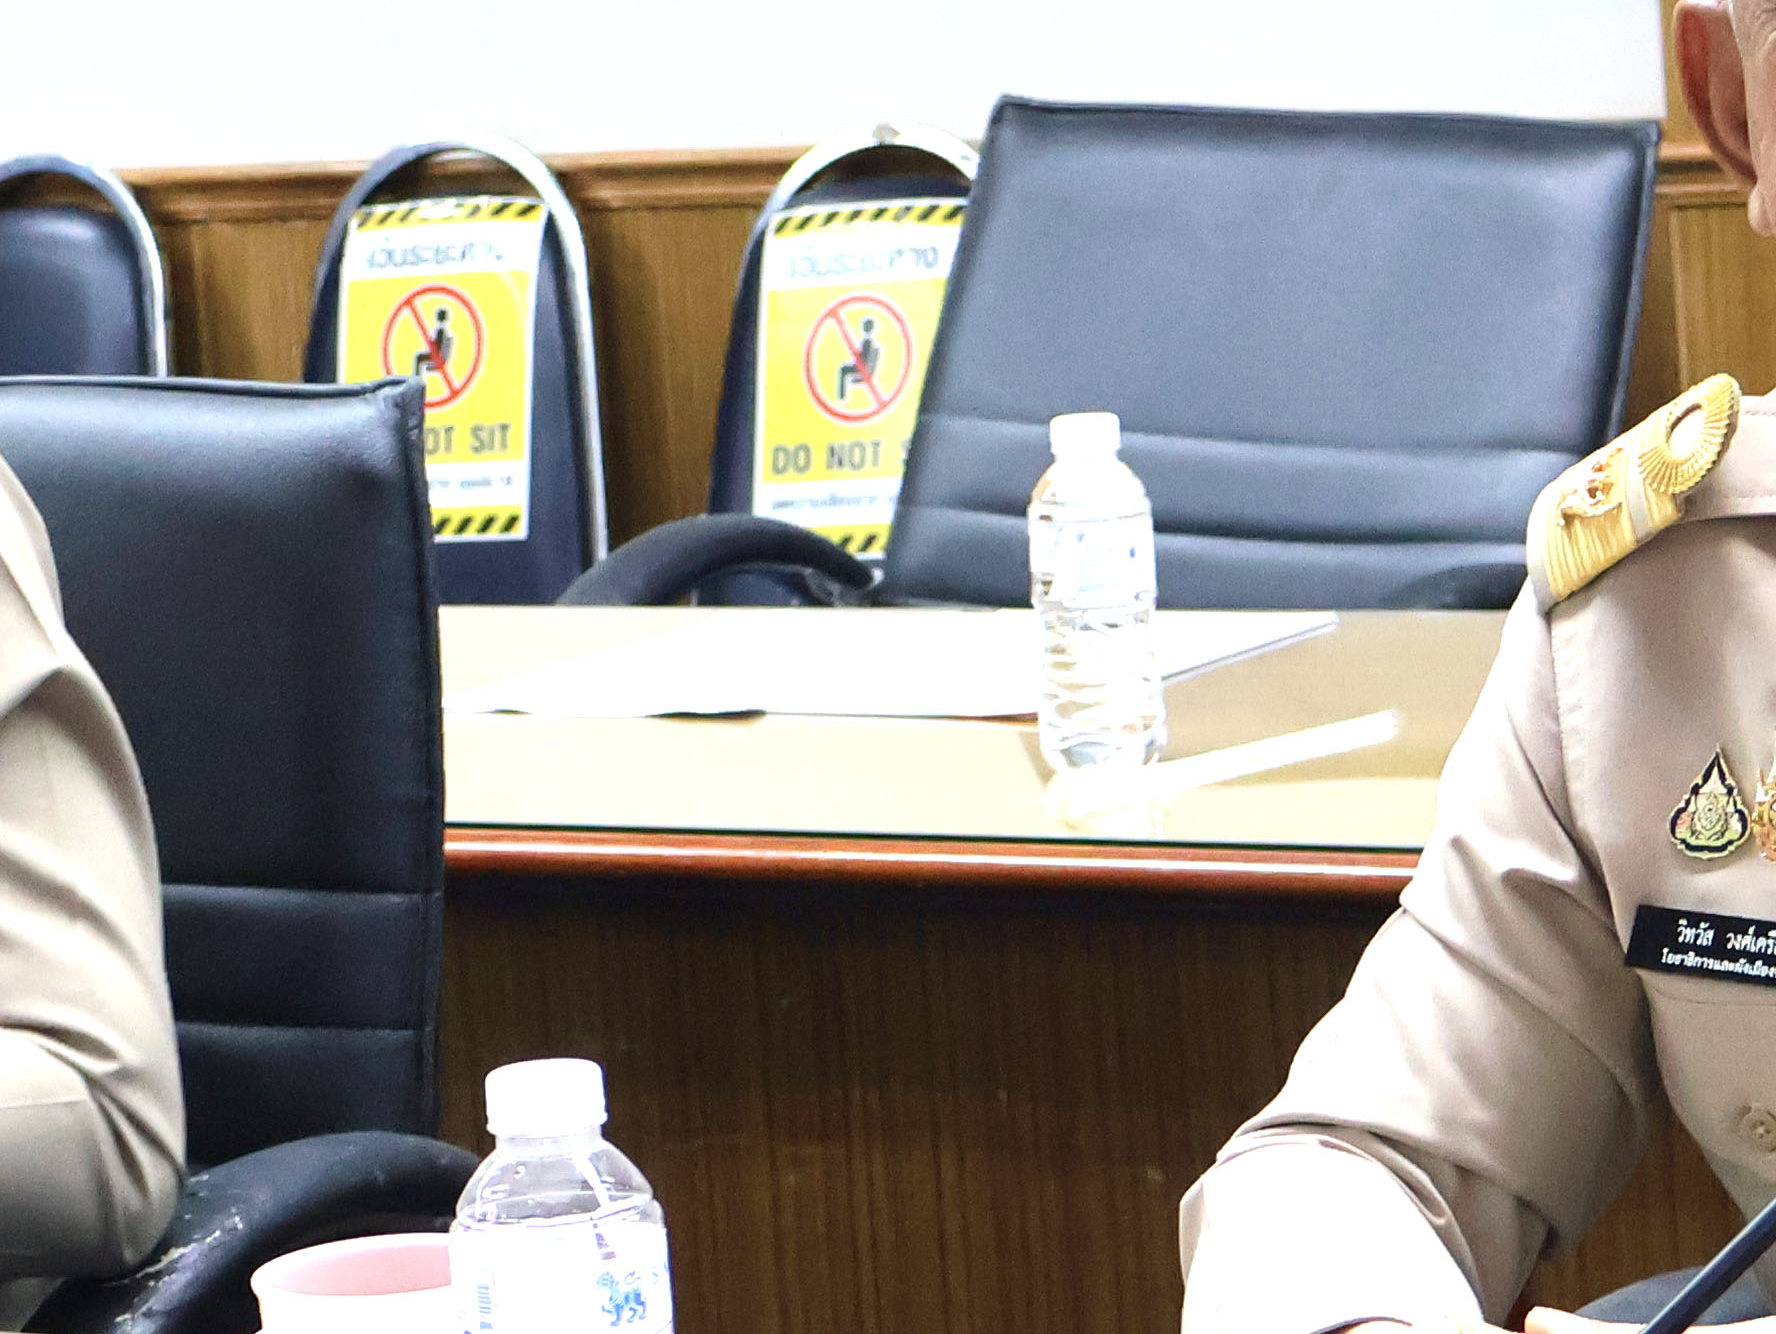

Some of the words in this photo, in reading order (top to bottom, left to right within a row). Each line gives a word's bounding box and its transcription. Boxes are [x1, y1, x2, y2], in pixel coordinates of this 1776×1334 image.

[425, 426, 454, 455] OT
[470, 423, 511, 455] SIT
[772, 443, 812, 475] DO
[826, 439, 881, 471] NOT
